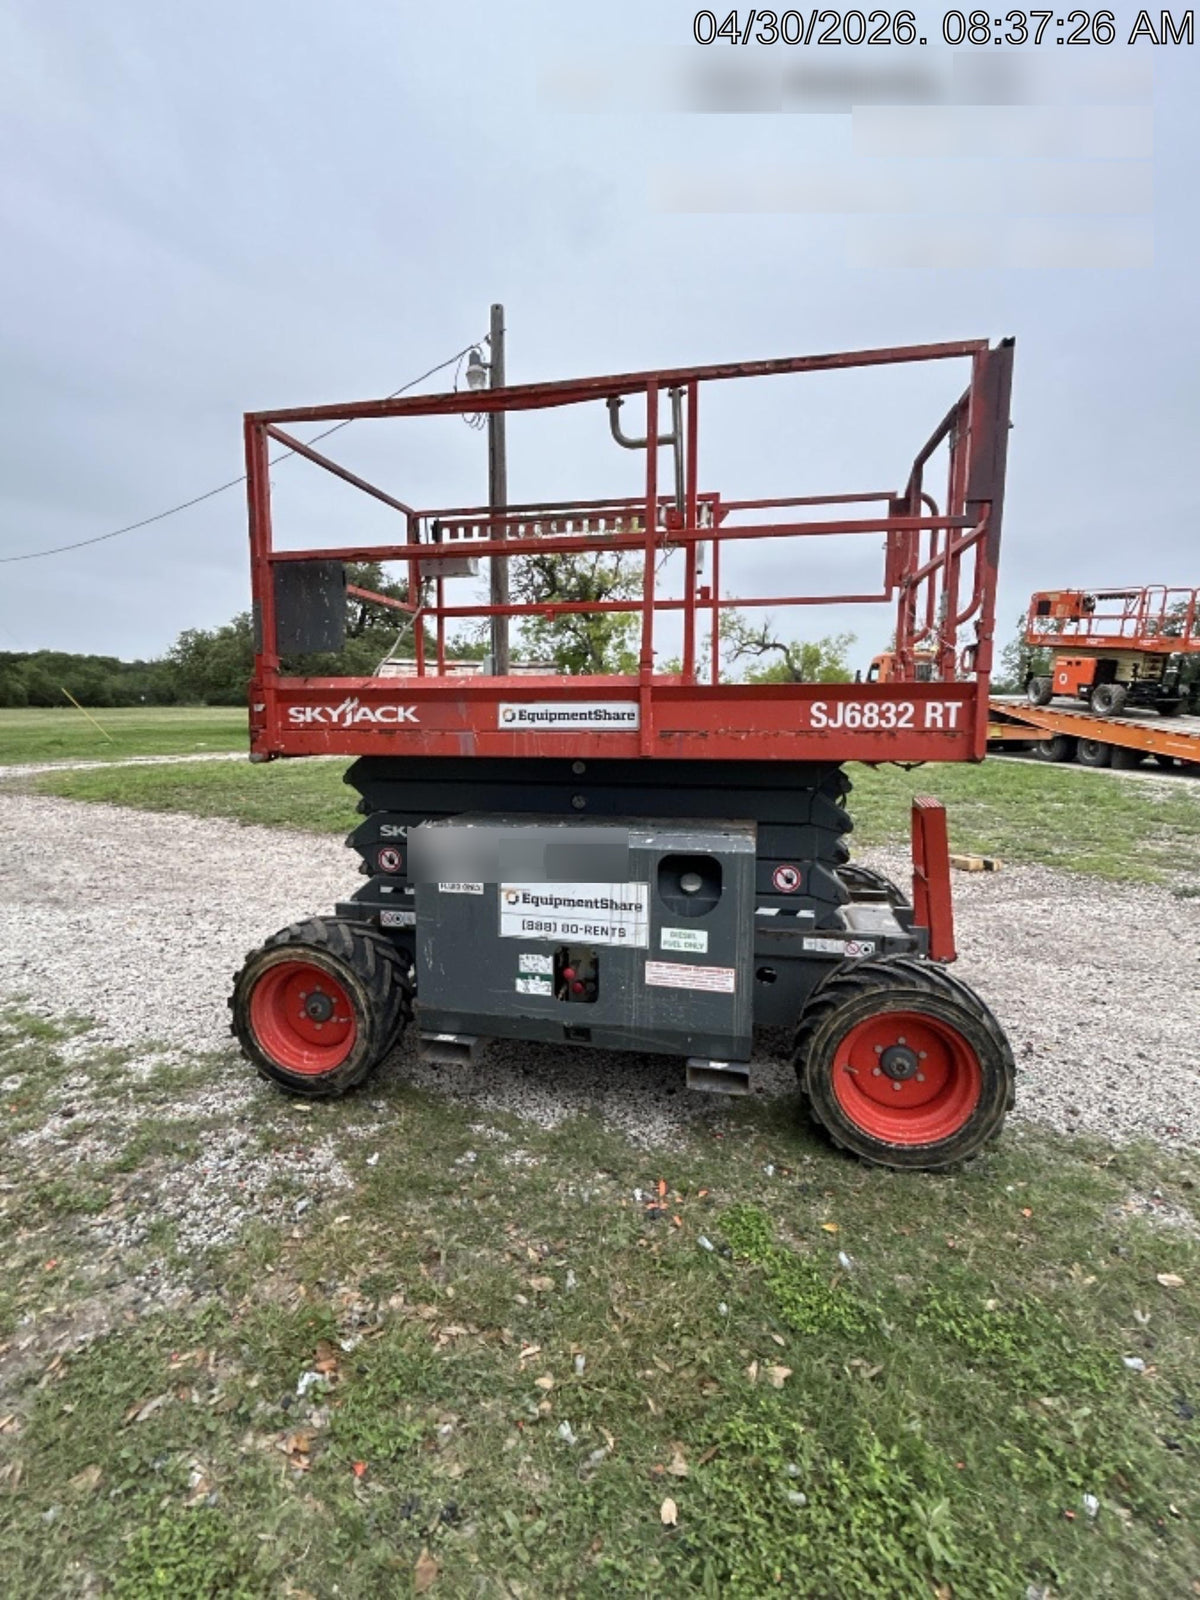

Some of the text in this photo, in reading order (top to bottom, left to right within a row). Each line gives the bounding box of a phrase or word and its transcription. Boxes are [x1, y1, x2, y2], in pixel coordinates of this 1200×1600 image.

[287, 696, 420, 727] SKYJACK
[517, 708, 636, 723] EquipmentShare
[810, 701, 963, 728] SJ6832 RT
[522, 892, 643, 912] EquipmentShare
